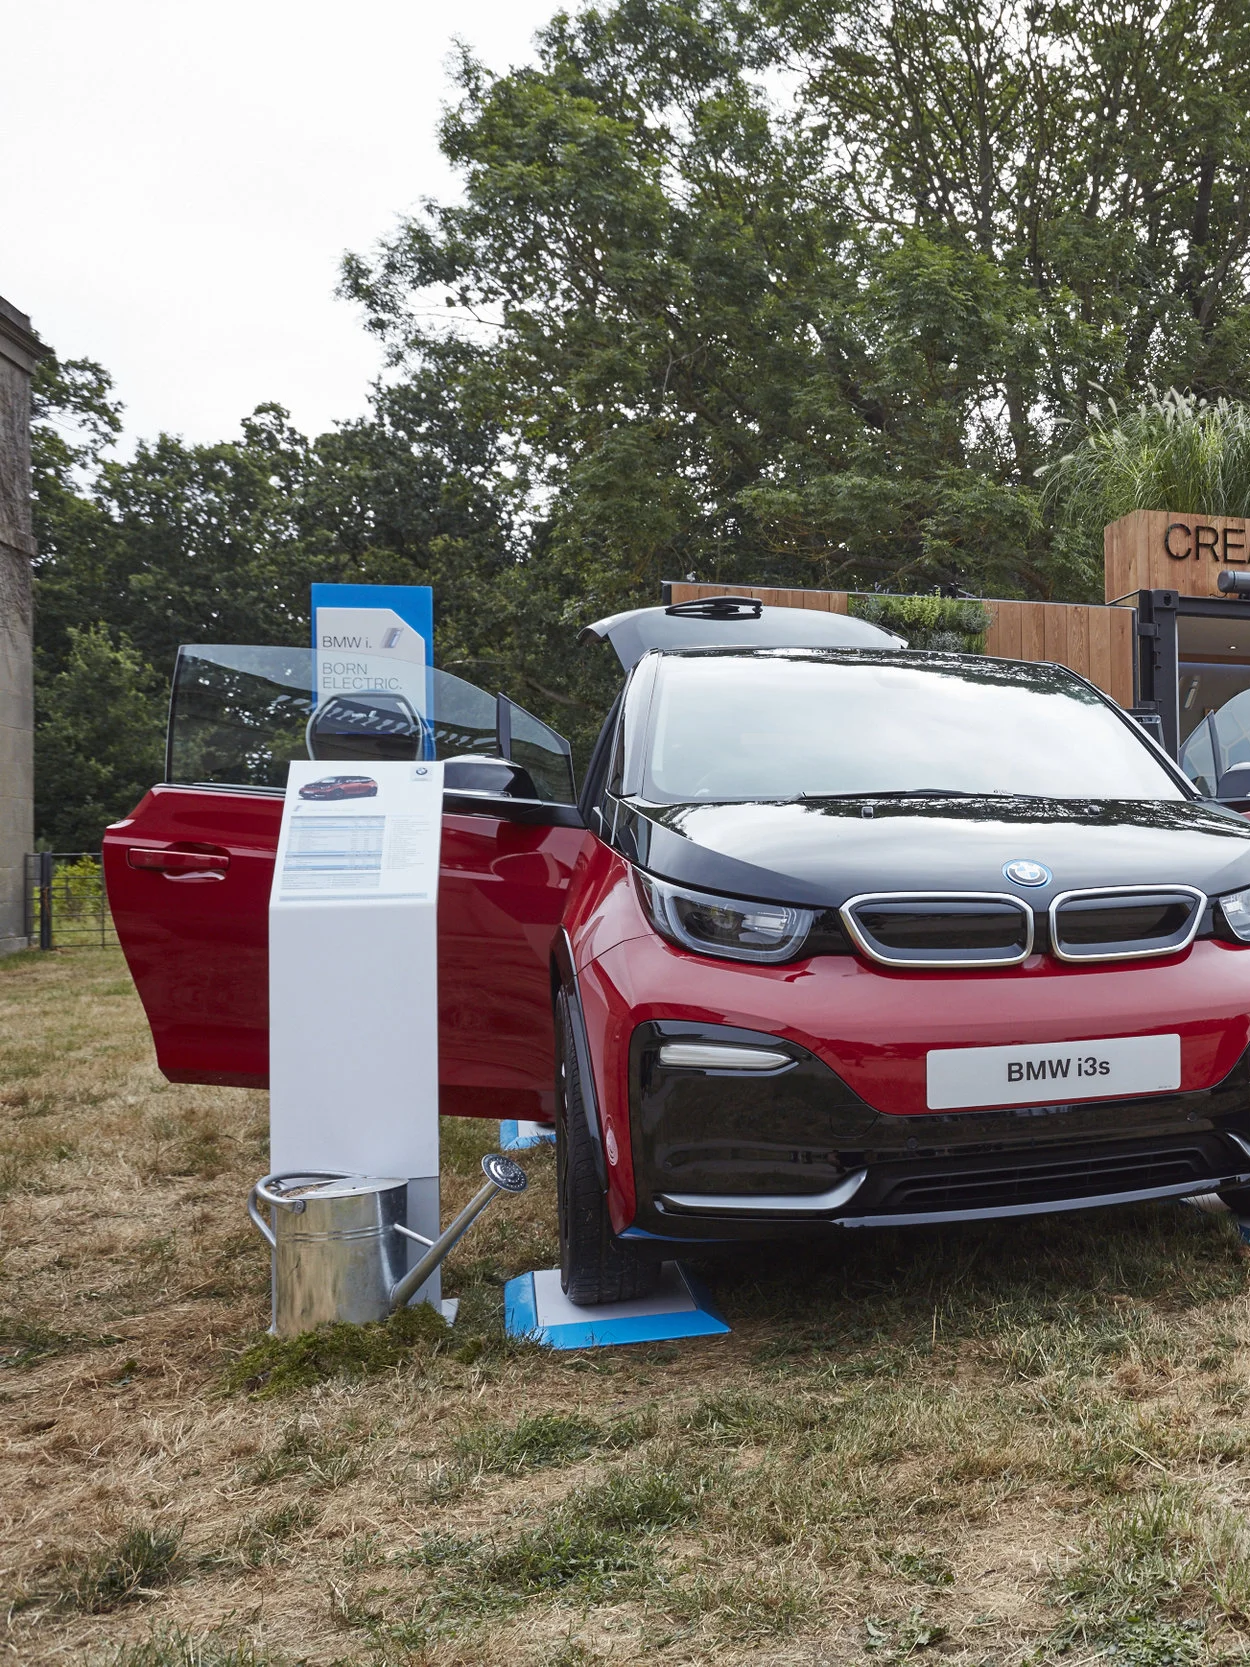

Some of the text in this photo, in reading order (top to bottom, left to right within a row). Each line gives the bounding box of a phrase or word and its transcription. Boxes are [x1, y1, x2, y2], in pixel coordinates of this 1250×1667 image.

[322, 635, 362, 649] BMW
[322, 662, 368, 675] BORN
[322, 676, 403, 690] ELECTRIC.
[1007, 1056, 1111, 1082] BMW i3s
